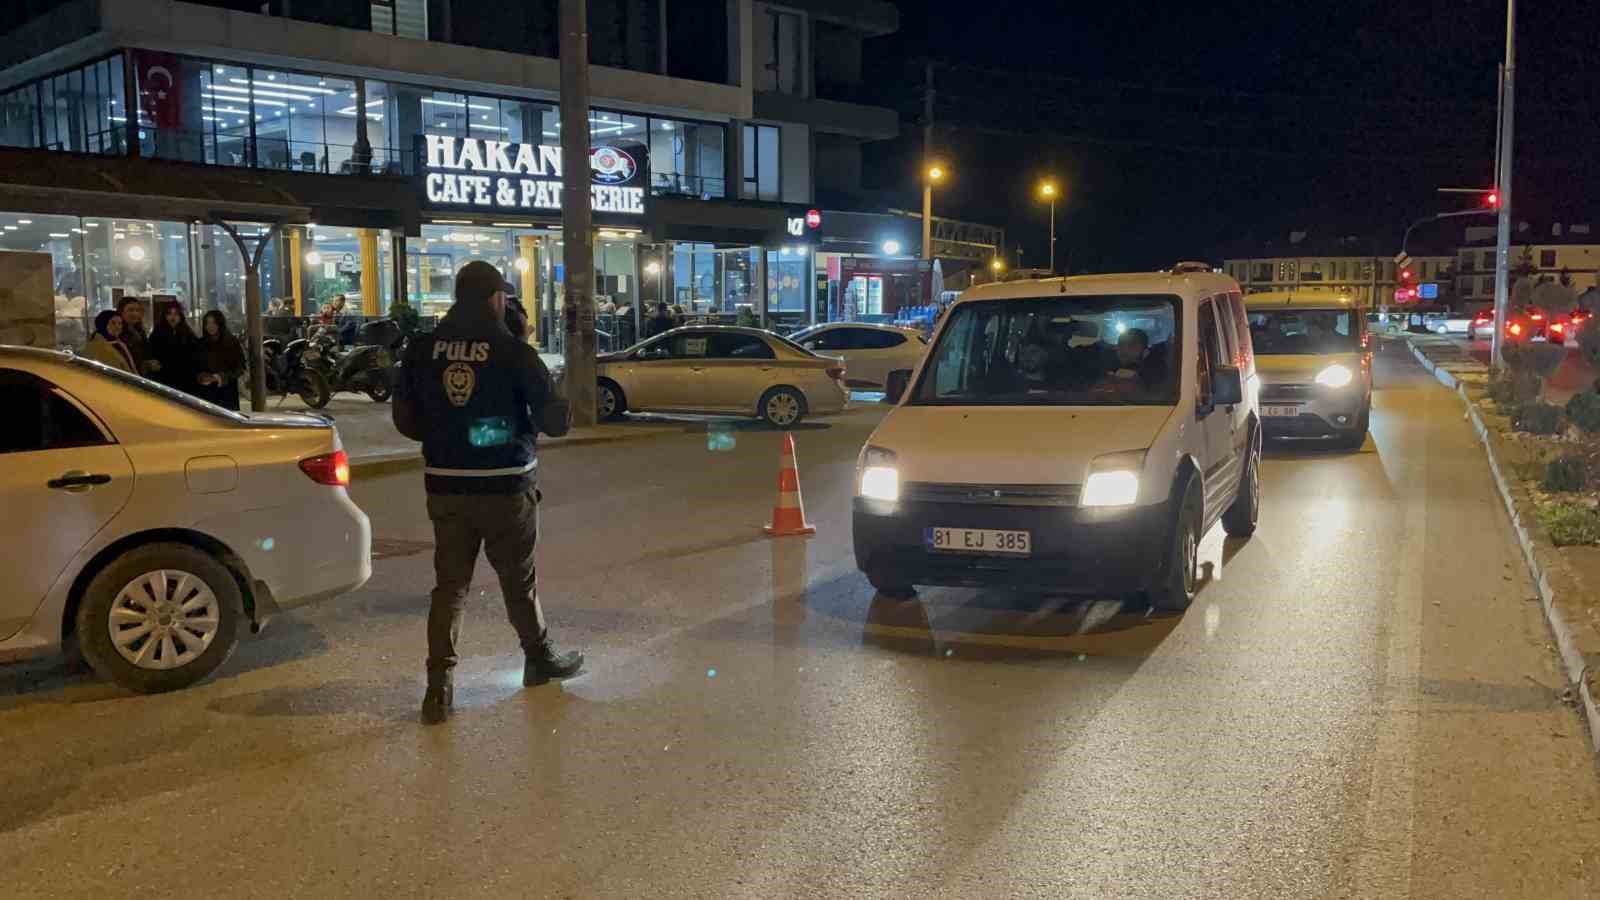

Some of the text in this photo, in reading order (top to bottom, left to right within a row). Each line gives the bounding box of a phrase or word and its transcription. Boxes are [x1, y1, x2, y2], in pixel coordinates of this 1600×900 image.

[425, 135, 562, 177] HAKAN
[426, 172, 491, 205] CAFE
[496, 178, 516, 208] &
[432, 340, 490, 362] POLIS
[935, 530, 1027, 550] 81 EJ 385
